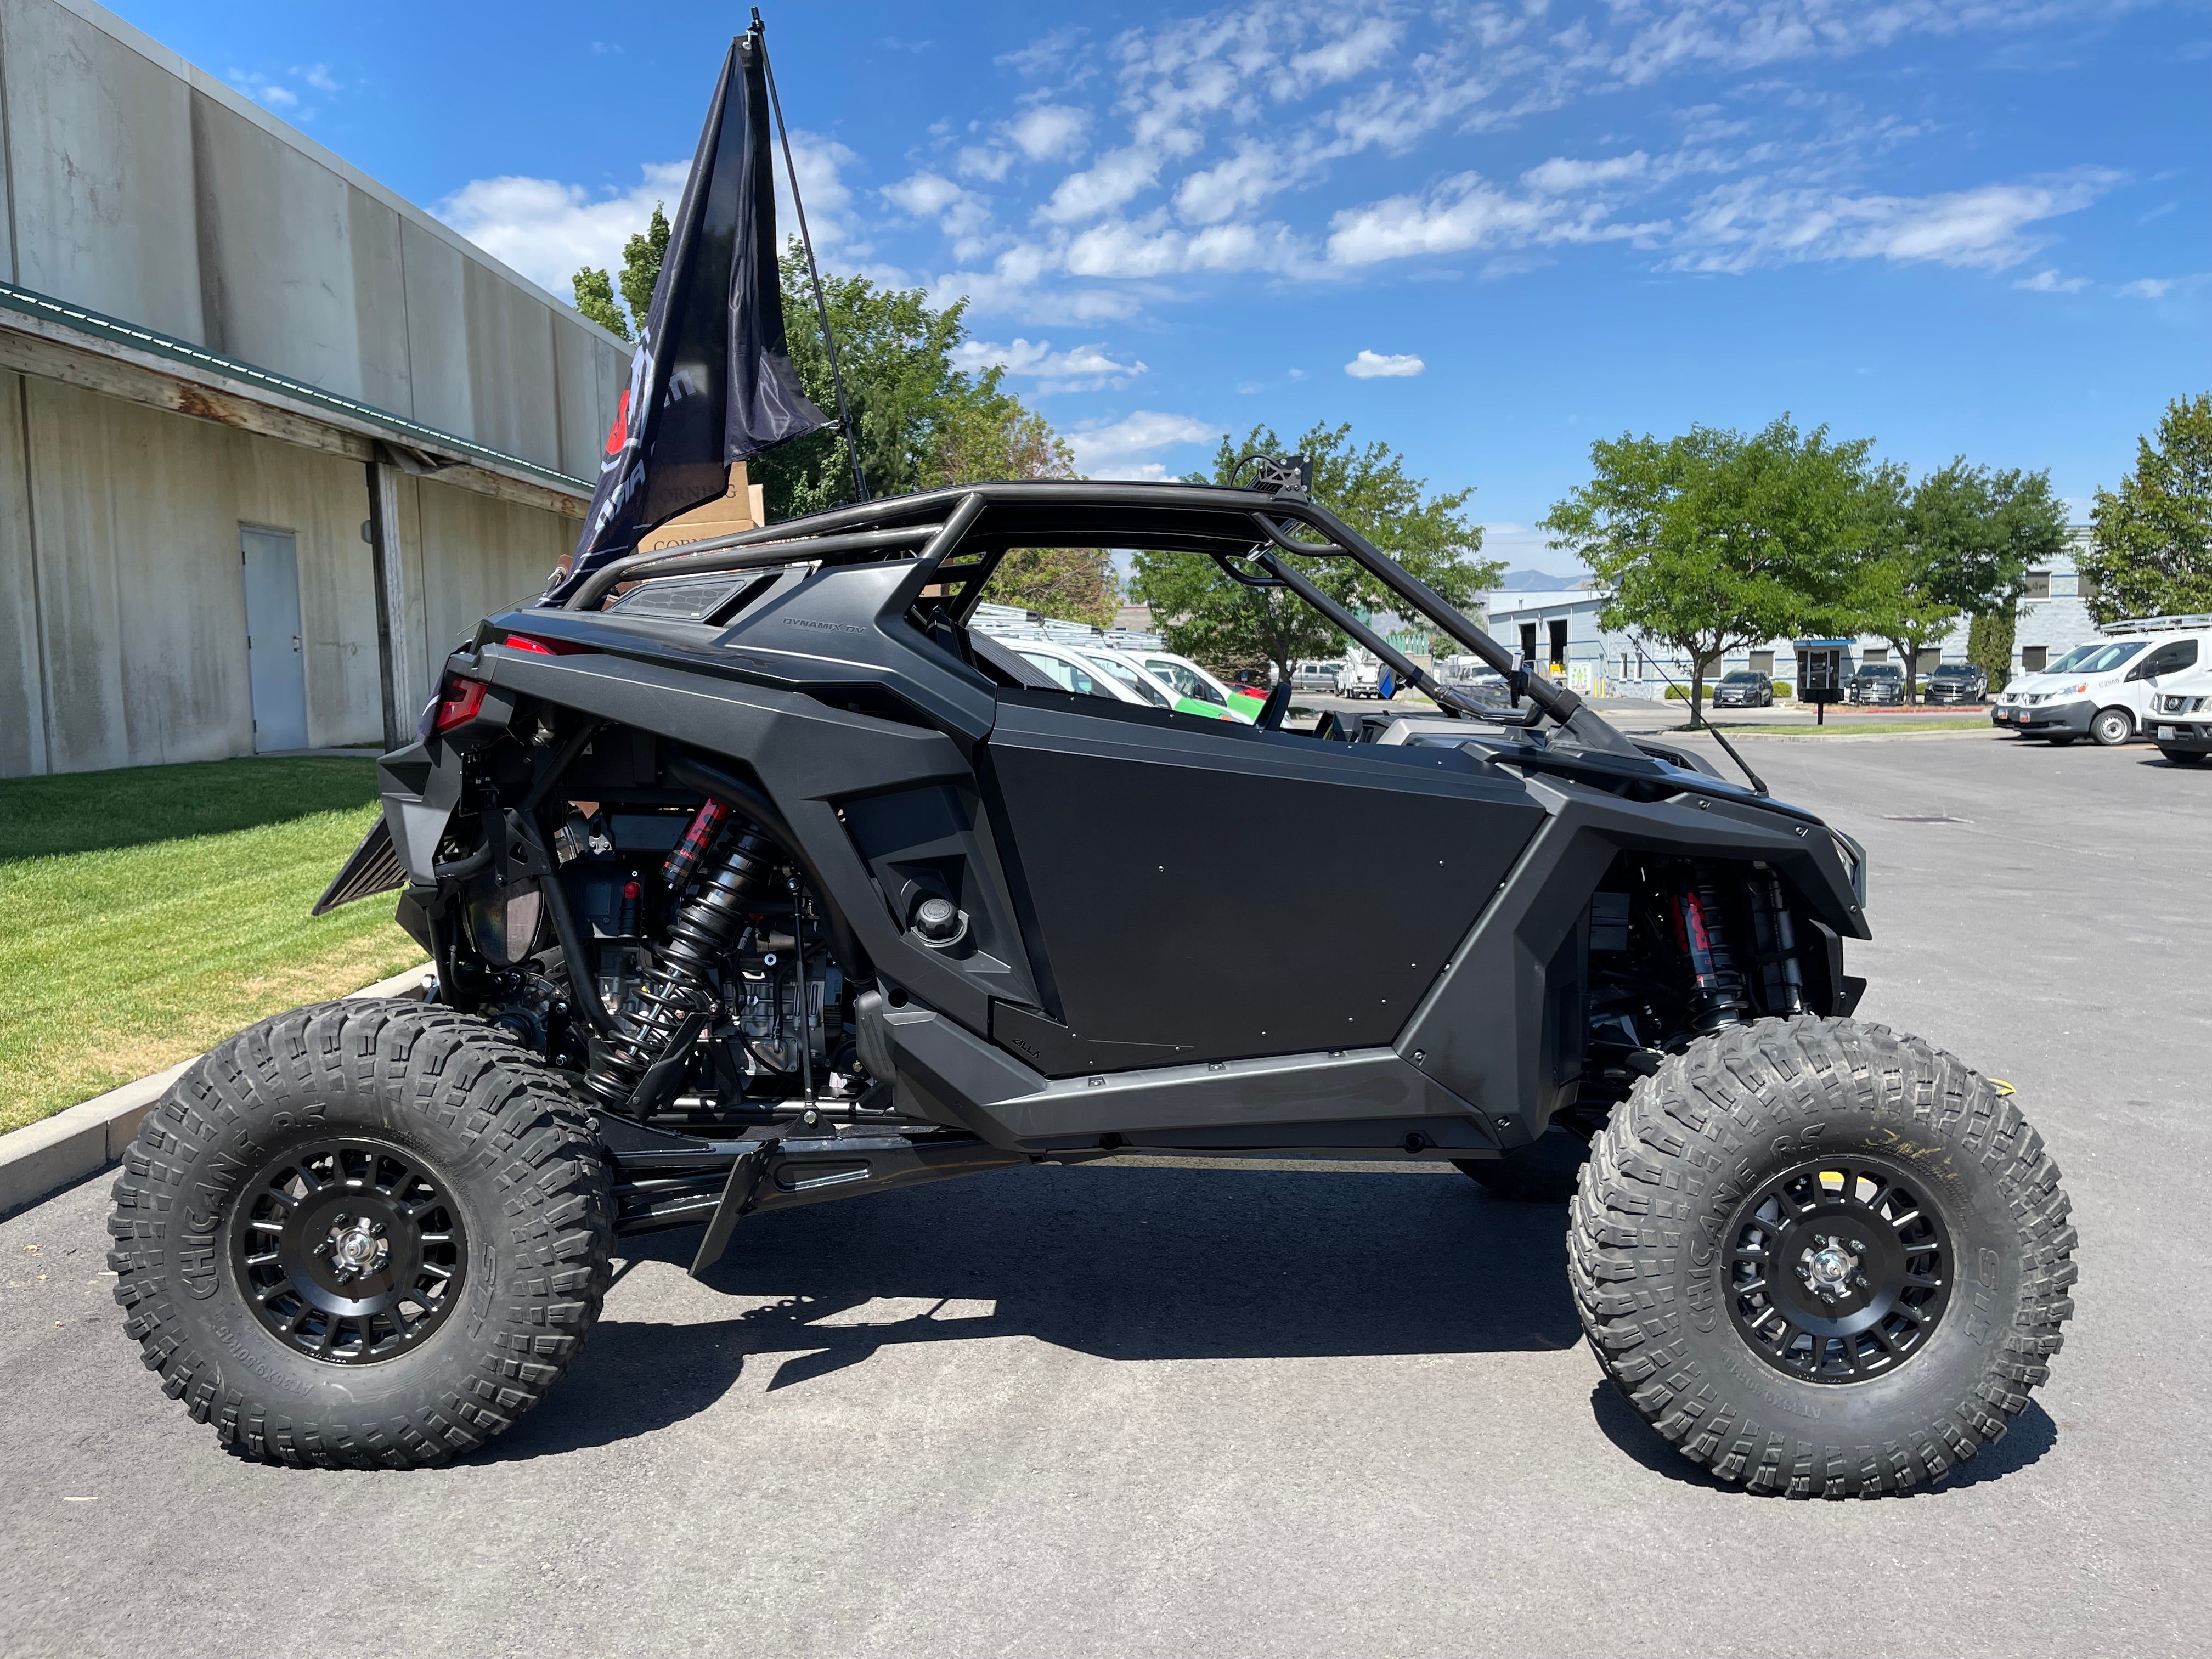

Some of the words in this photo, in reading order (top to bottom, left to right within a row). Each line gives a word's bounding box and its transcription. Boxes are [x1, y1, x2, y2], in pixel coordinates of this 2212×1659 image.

[782, 618, 843, 632] DYNAMIX
[845, 625, 867, 635] DV
[1011, 1037, 1040, 1060] ZILLA
[179, 1128, 265, 1300] CHICANE
[1686, 1156, 1758, 1333] CHICANE
[1770, 1122, 1826, 1161] RS
[1963, 1247, 2000, 1346] STI
